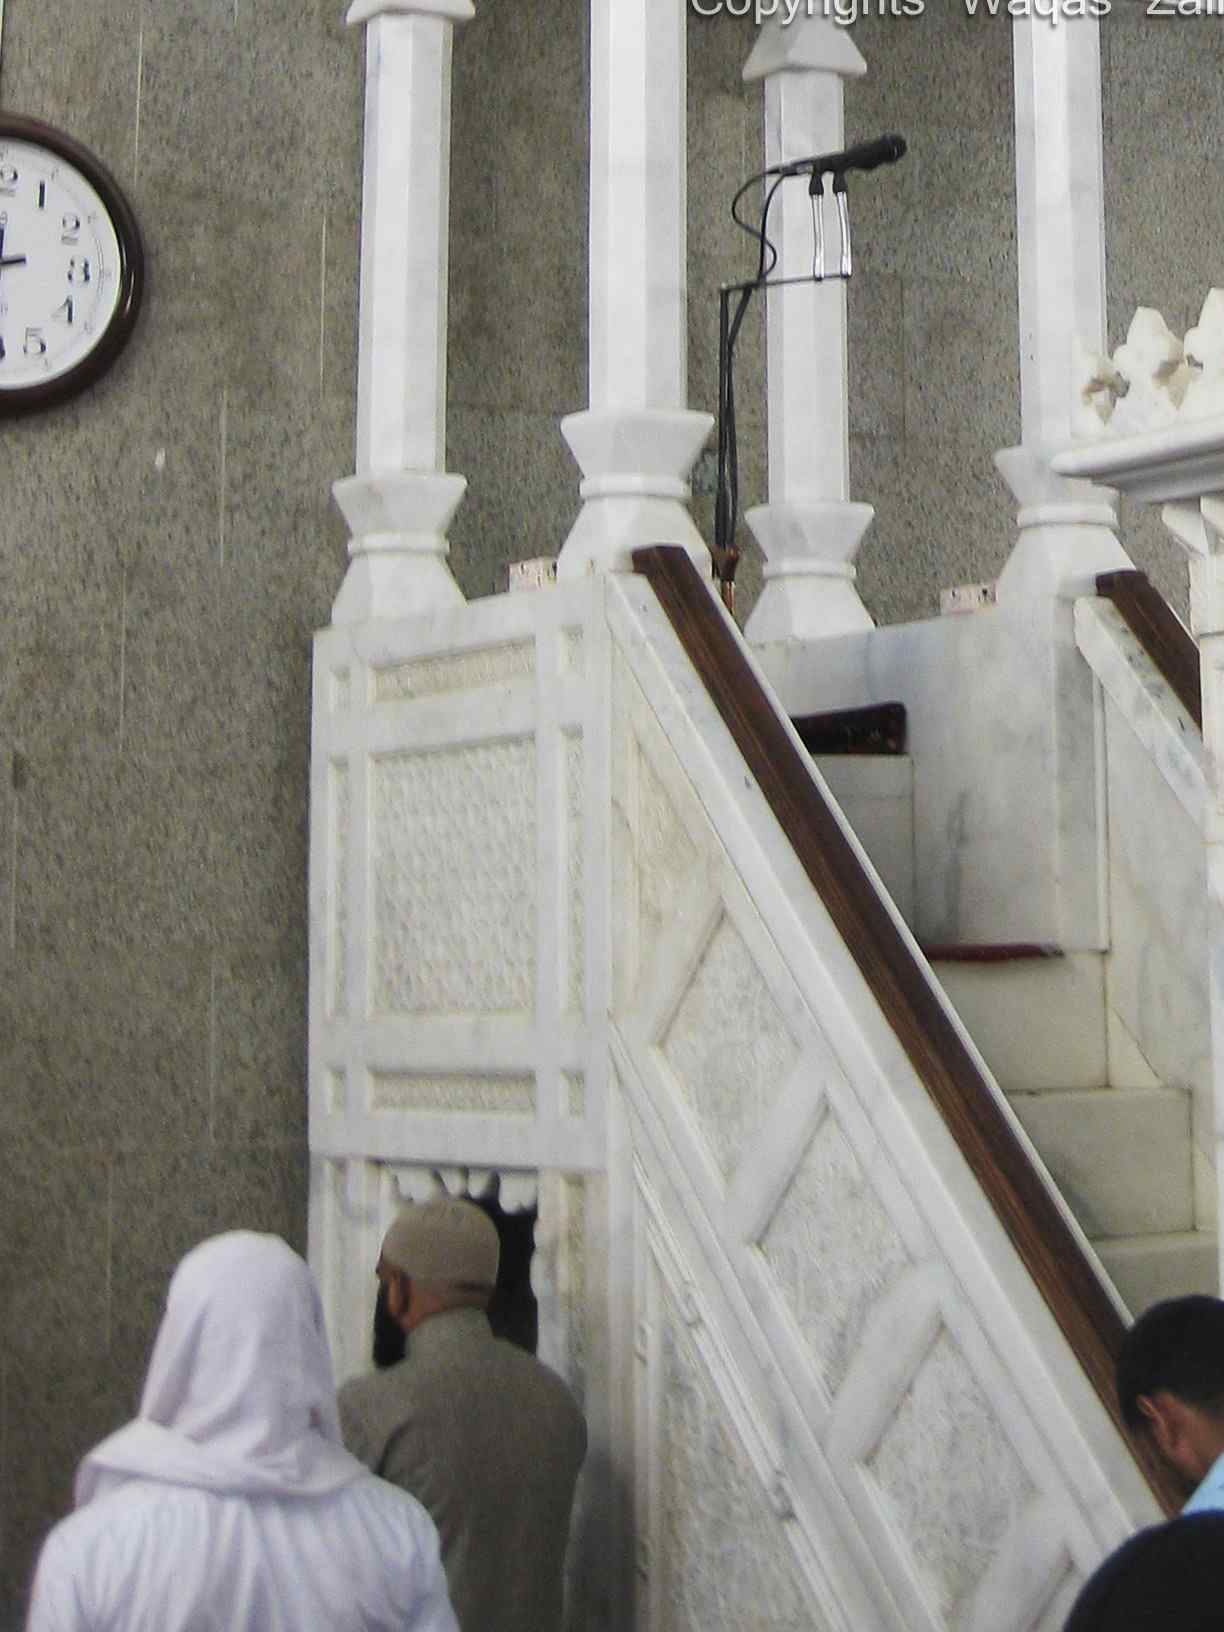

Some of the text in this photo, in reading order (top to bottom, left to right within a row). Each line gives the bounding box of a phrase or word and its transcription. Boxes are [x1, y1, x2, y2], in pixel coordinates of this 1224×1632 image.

[61, 215, 81, 245] 2
[51, 294, 74, 324] 4
[23, 326, 47, 361] 5
